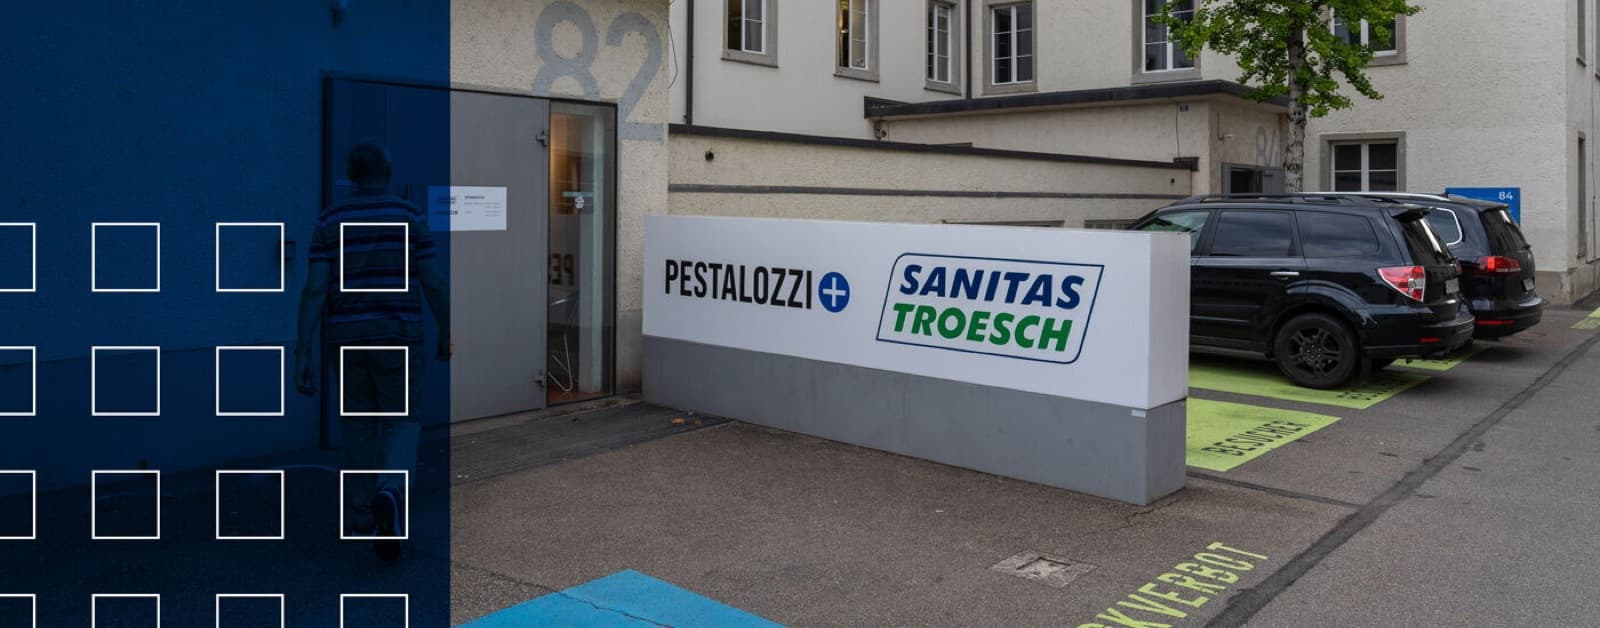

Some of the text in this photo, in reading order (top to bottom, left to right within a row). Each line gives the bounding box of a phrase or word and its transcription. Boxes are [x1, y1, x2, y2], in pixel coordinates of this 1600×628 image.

[533, 0, 663, 140] 82
[1498, 191, 1513, 200] 84
[665, 259, 812, 310] PESTALOZZI
[899, 264, 1086, 310] SANITAS
[893, 303, 1073, 352] TROESCH
[1200, 420, 1313, 457] BESUCHER
[1076, 541, 1269, 628] KVERBOT
